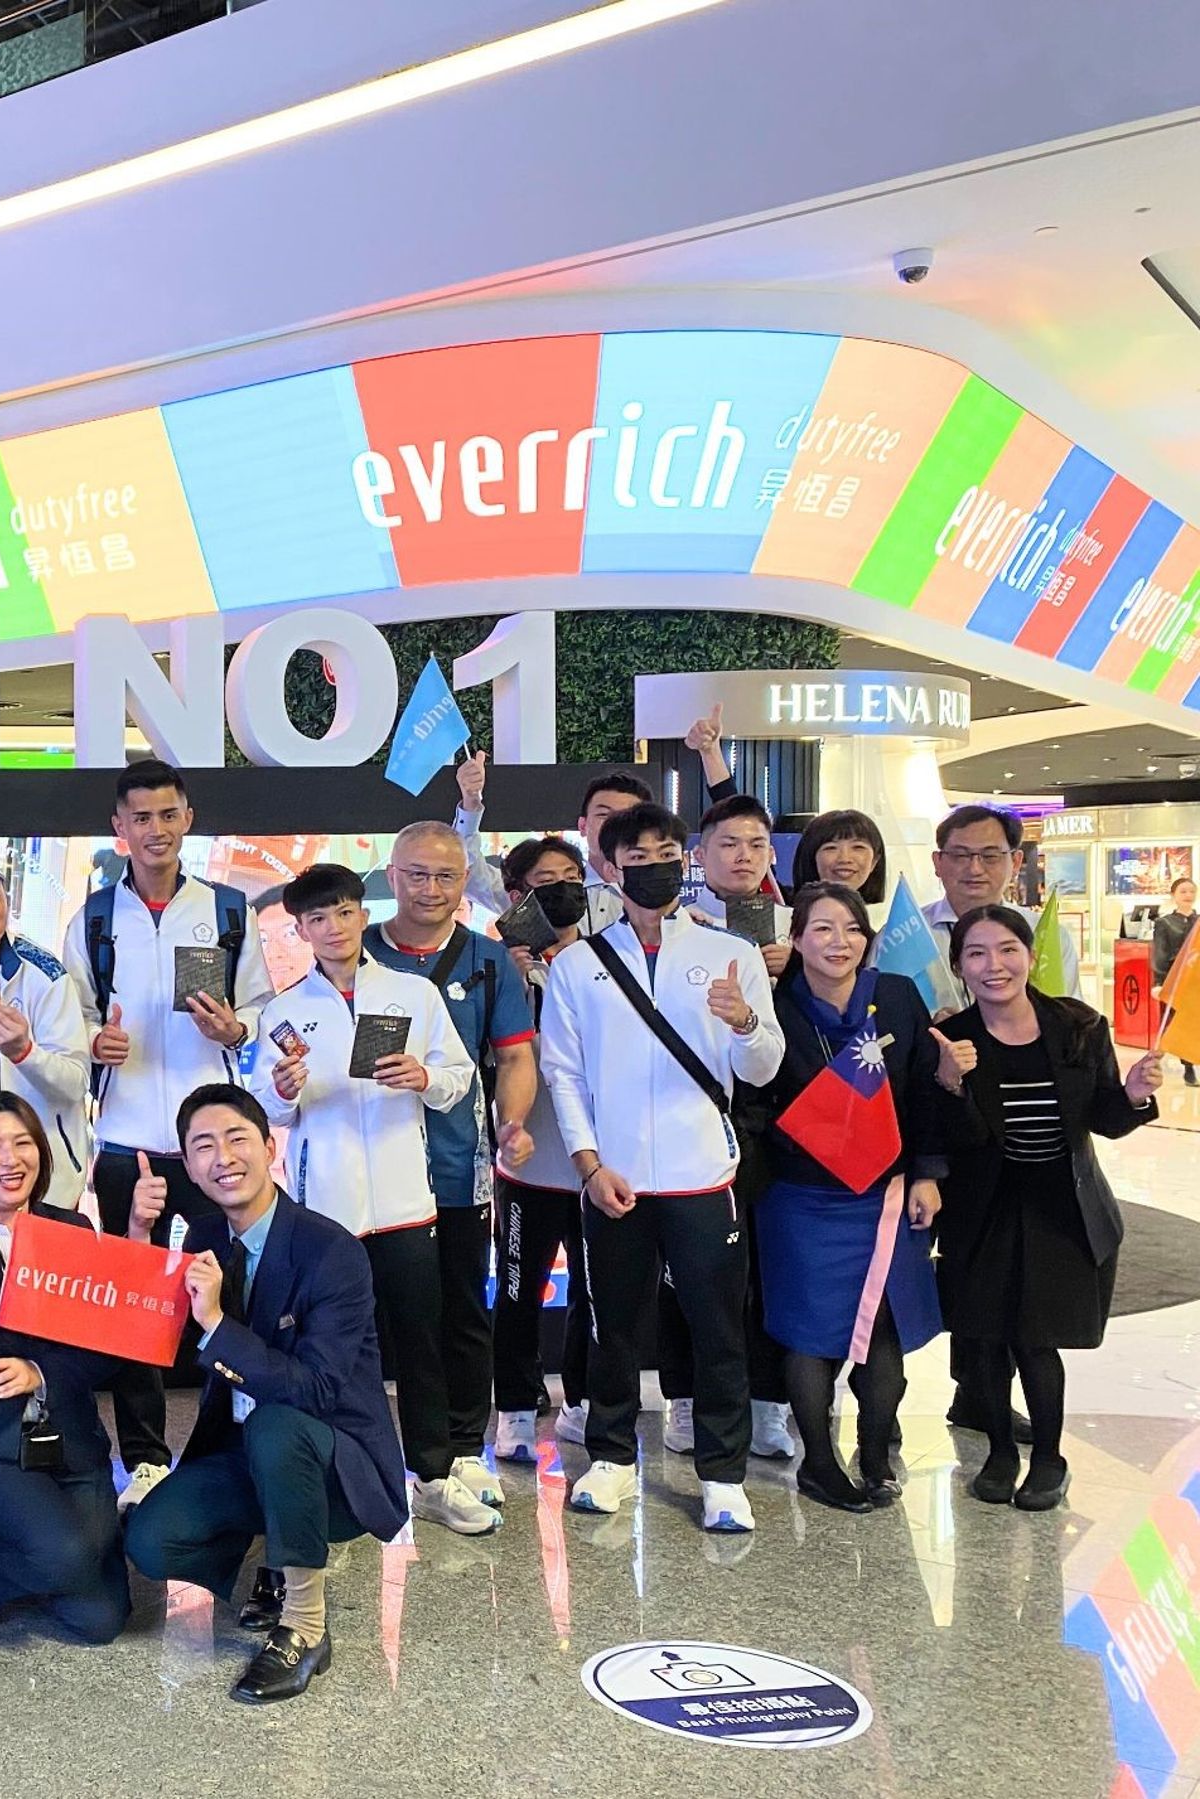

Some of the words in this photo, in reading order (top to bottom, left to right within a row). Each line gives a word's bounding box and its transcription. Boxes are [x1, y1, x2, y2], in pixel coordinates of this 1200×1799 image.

[775, 404, 902, 466] dutyfree
[352, 400, 746, 528] everrich
[10, 484, 139, 536] dutyfree
[935, 485, 1067, 592] everrich
[75, 607, 398, 766] NO
[453, 610, 556, 765] 1
[768, 684, 934, 725] HELENA
[508, 1202, 523, 1261] CHINESE
[16, 1265, 118, 1308] everrich
[676, 1716, 716, 1729] Best
[715, 1709, 812, 1725] Photography
[814, 1706, 856, 1718] Point
[680, 1694, 818, 1717] 最佳拍攝點
